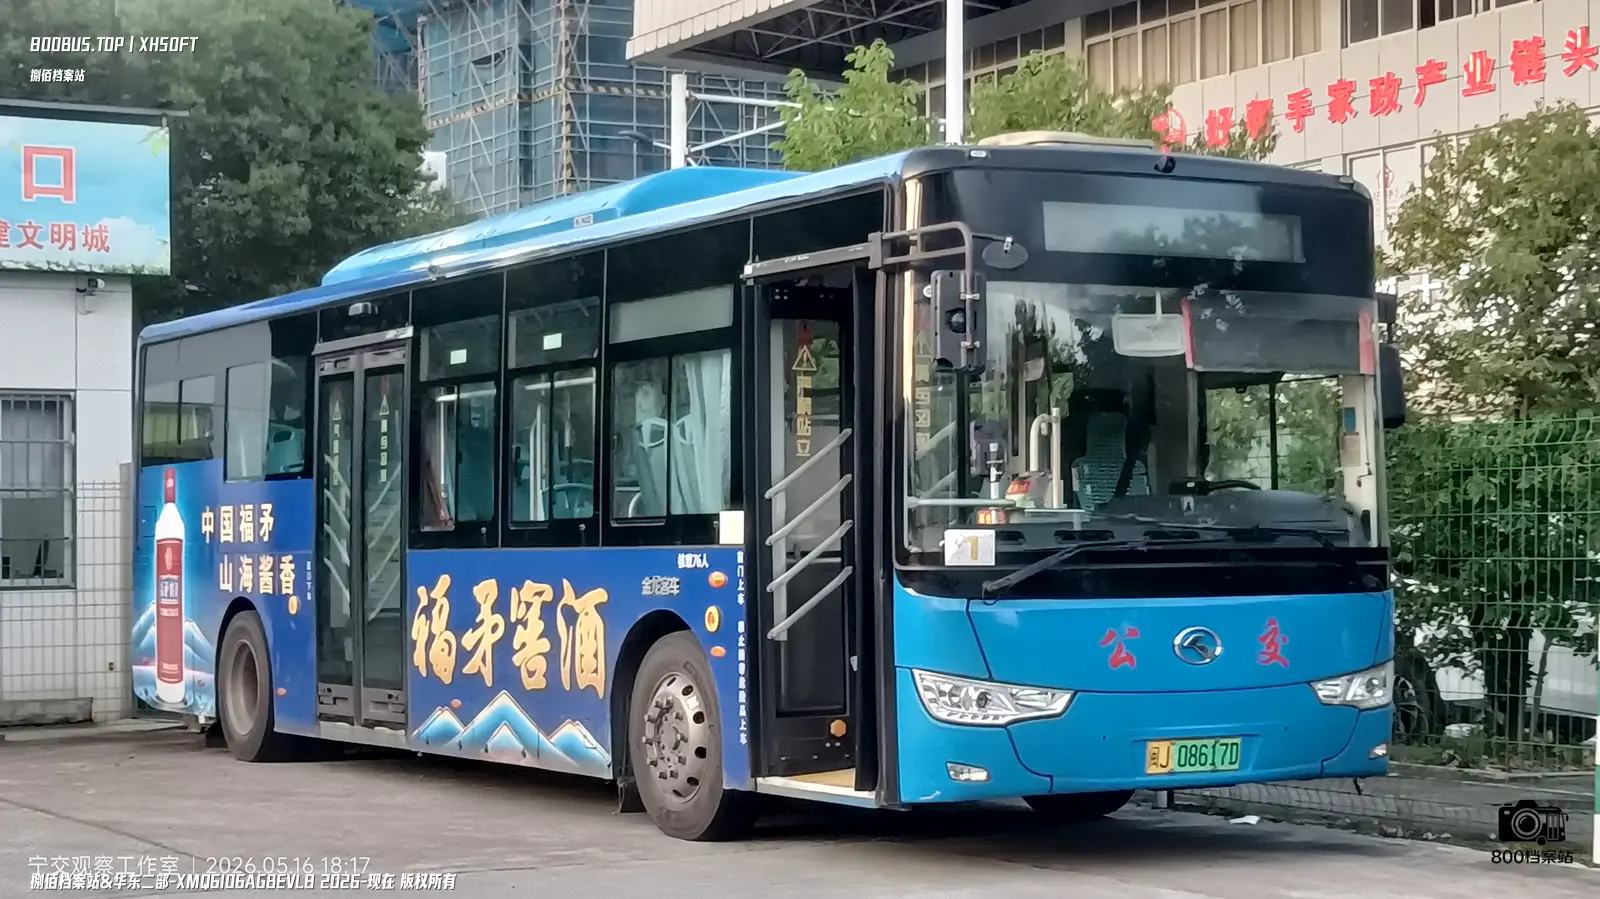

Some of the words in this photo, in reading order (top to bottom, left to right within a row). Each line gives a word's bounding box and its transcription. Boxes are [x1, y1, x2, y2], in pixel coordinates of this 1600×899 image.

[22, 144, 76, 204] 口
[201, 503, 275, 544] 中国福矛
[219, 554, 296, 596] 山海酱香
[411, 573, 609, 700] 福矛窖酒
